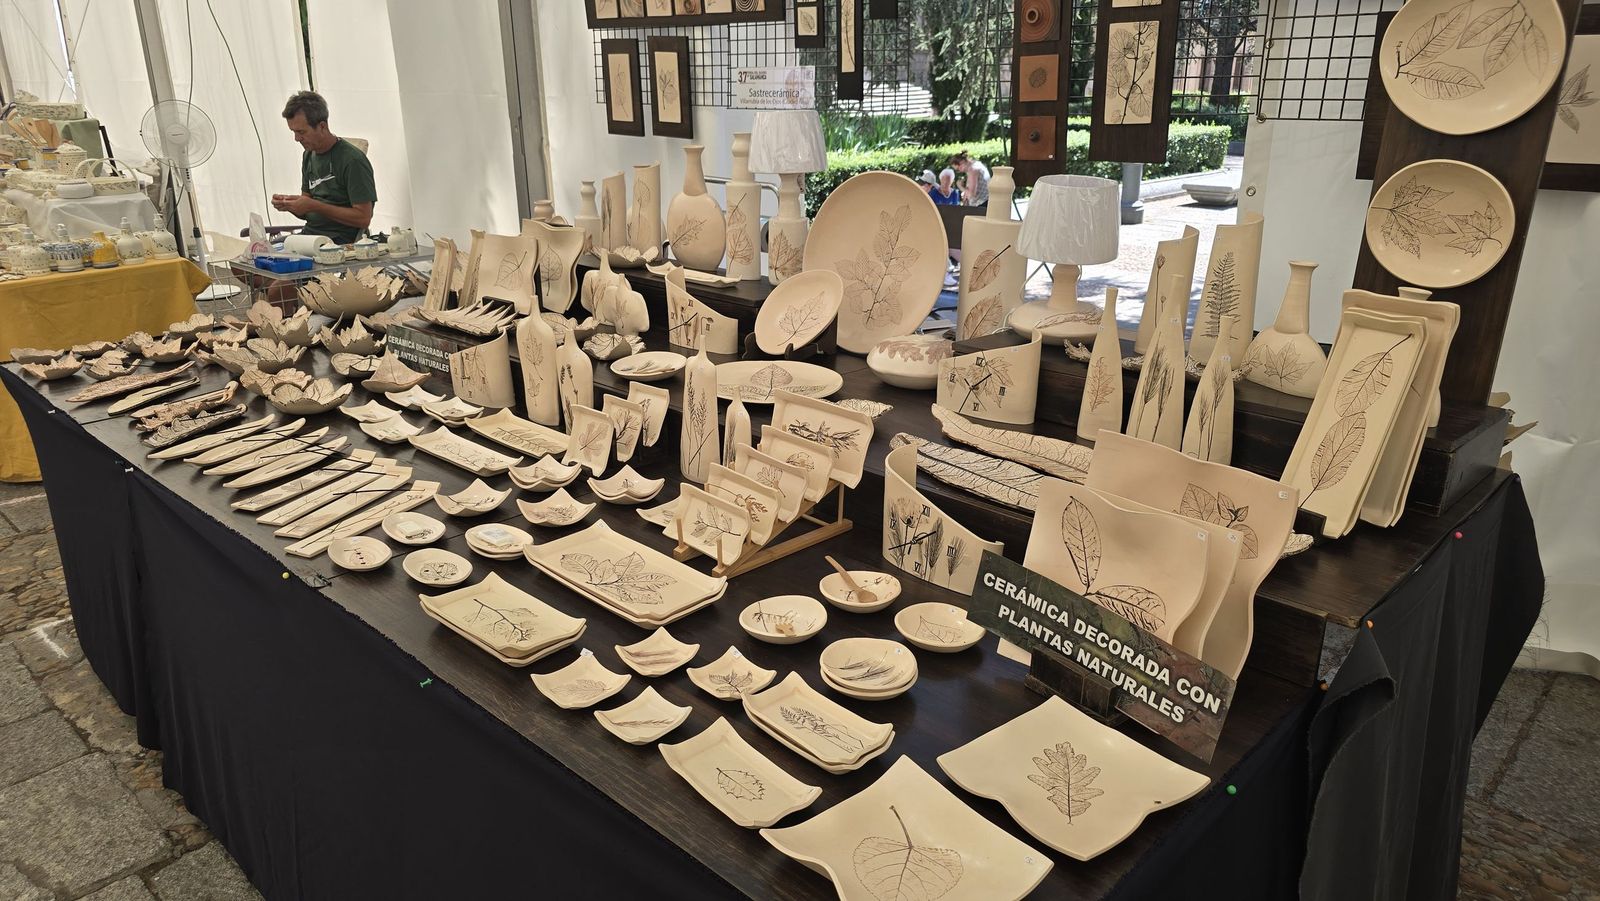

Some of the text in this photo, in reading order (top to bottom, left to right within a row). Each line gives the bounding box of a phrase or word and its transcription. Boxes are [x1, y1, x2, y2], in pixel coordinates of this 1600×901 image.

[748, 88, 800, 98] Sastrecerámica
[388, 335, 415, 349] CERÁMICA
[415, 343, 443, 359] DECORADA
[394, 349, 417, 363] PLANTAS
[418, 356, 450, 373] NATURALES
[983, 572, 1221, 715] CERÁMICA DECORADA CON
[998, 604, 1185, 723] PLANTAS NATURALES
